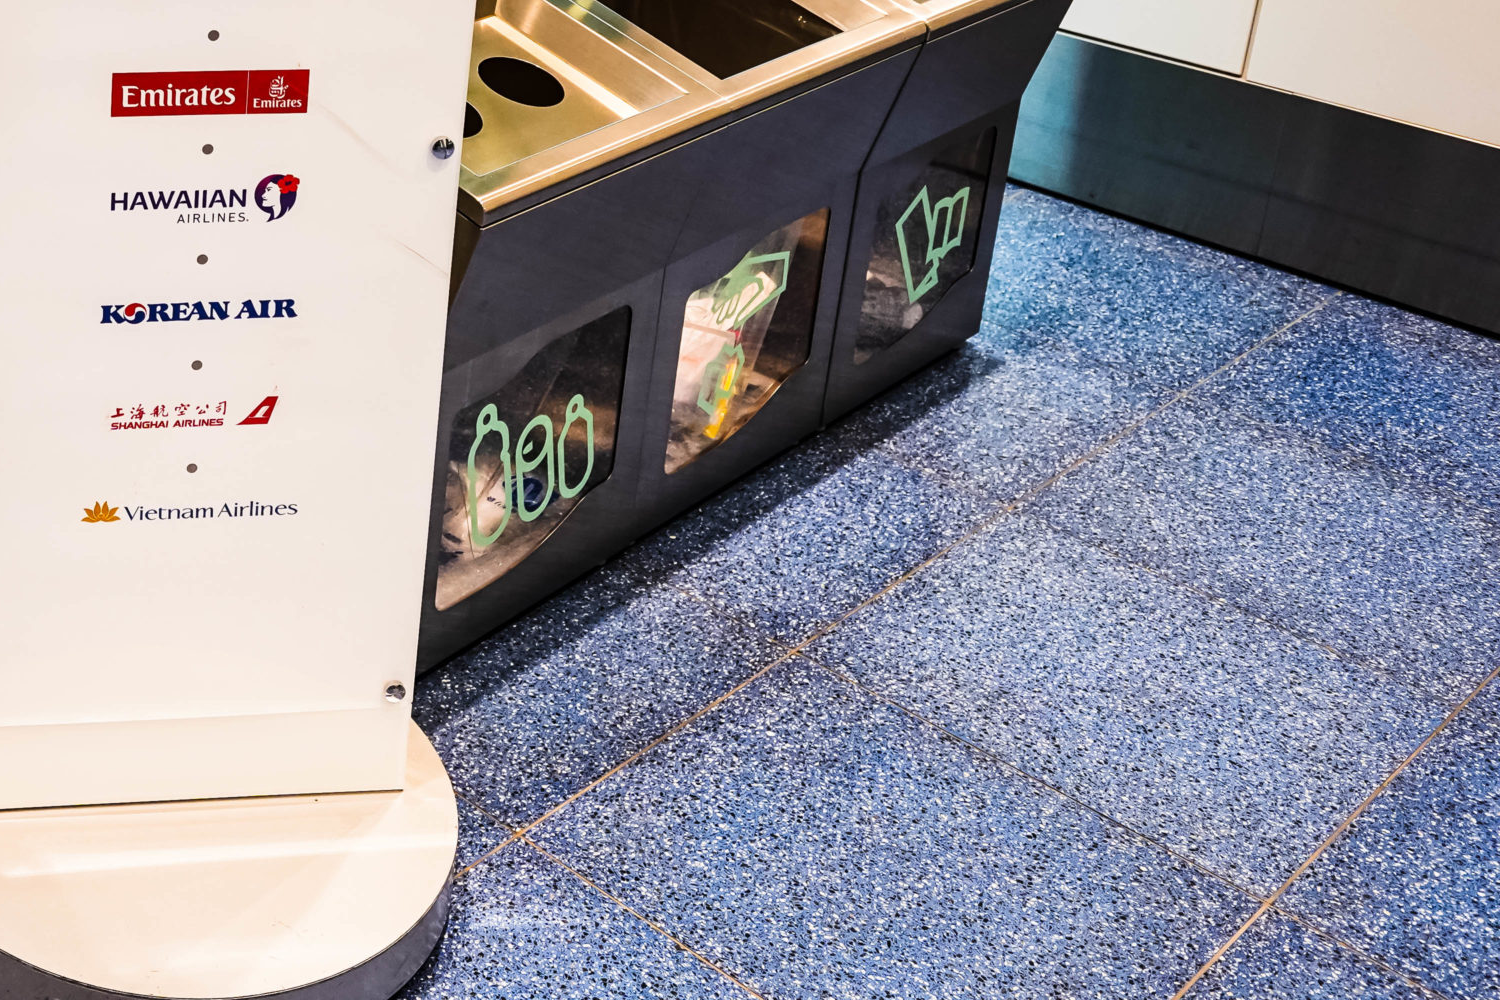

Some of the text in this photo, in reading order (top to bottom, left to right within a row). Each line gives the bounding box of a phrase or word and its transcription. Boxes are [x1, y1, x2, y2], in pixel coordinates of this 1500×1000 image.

[121, 82, 236, 108] Emirates
[252, 96, 303, 109] Emirates
[110, 188, 248, 212] HAWAIIAN
[100, 298, 299, 325] KOREAN AIR
[110, 400, 228, 421] 上海航空公司
[109, 417, 225, 431] SHANGHAI AIRLINES
[123, 500, 299, 522] Vietnam Airlines
